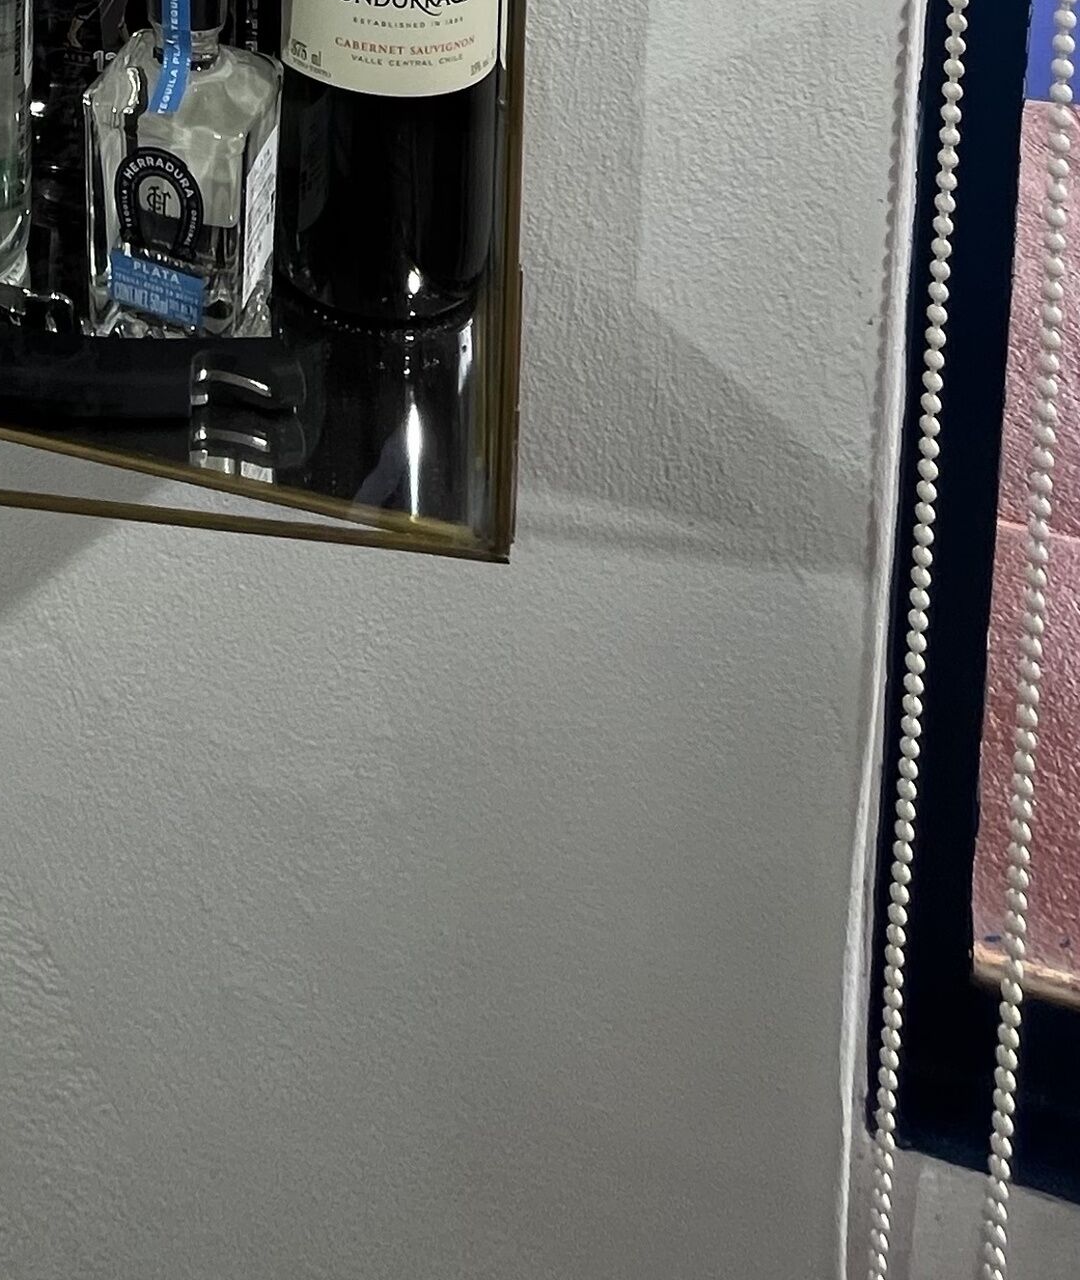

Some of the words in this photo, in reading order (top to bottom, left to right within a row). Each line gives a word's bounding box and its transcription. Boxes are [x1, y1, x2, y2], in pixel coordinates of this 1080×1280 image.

[353, 16, 426, 29] ESTABLISHED
[334, 36, 404, 56] CABERNET
[410, 35, 476, 56] SAUVIGNON
[351, 53, 383, 66] VALLE
[388, 59, 434, 67] CENTRAL
[438, 53, 464, 65] CHILE
[157, 69, 178, 114] TEQUILA
[123, 156, 195, 198] HERRADURA
[133, 260, 180, 285] PLATA
